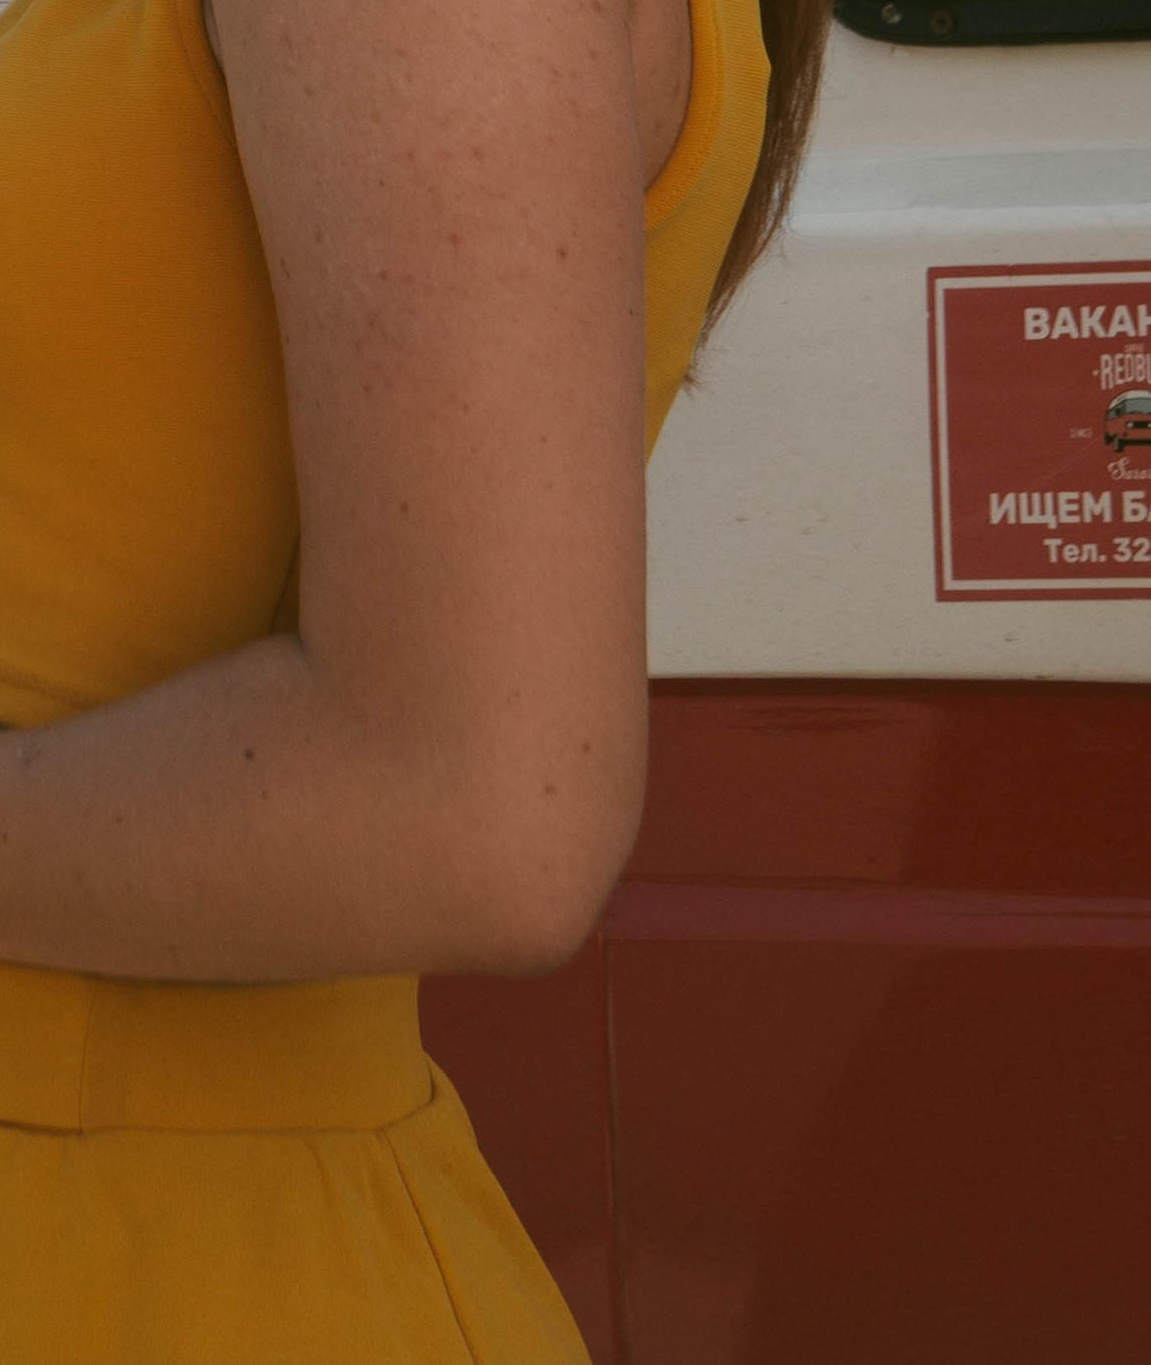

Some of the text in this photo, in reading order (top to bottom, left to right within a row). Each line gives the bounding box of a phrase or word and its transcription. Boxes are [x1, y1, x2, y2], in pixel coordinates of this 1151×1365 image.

[989, 489, 1151, 530] ИЩЕМ Б
[1043, 536, 1151, 564] Тел. 32
